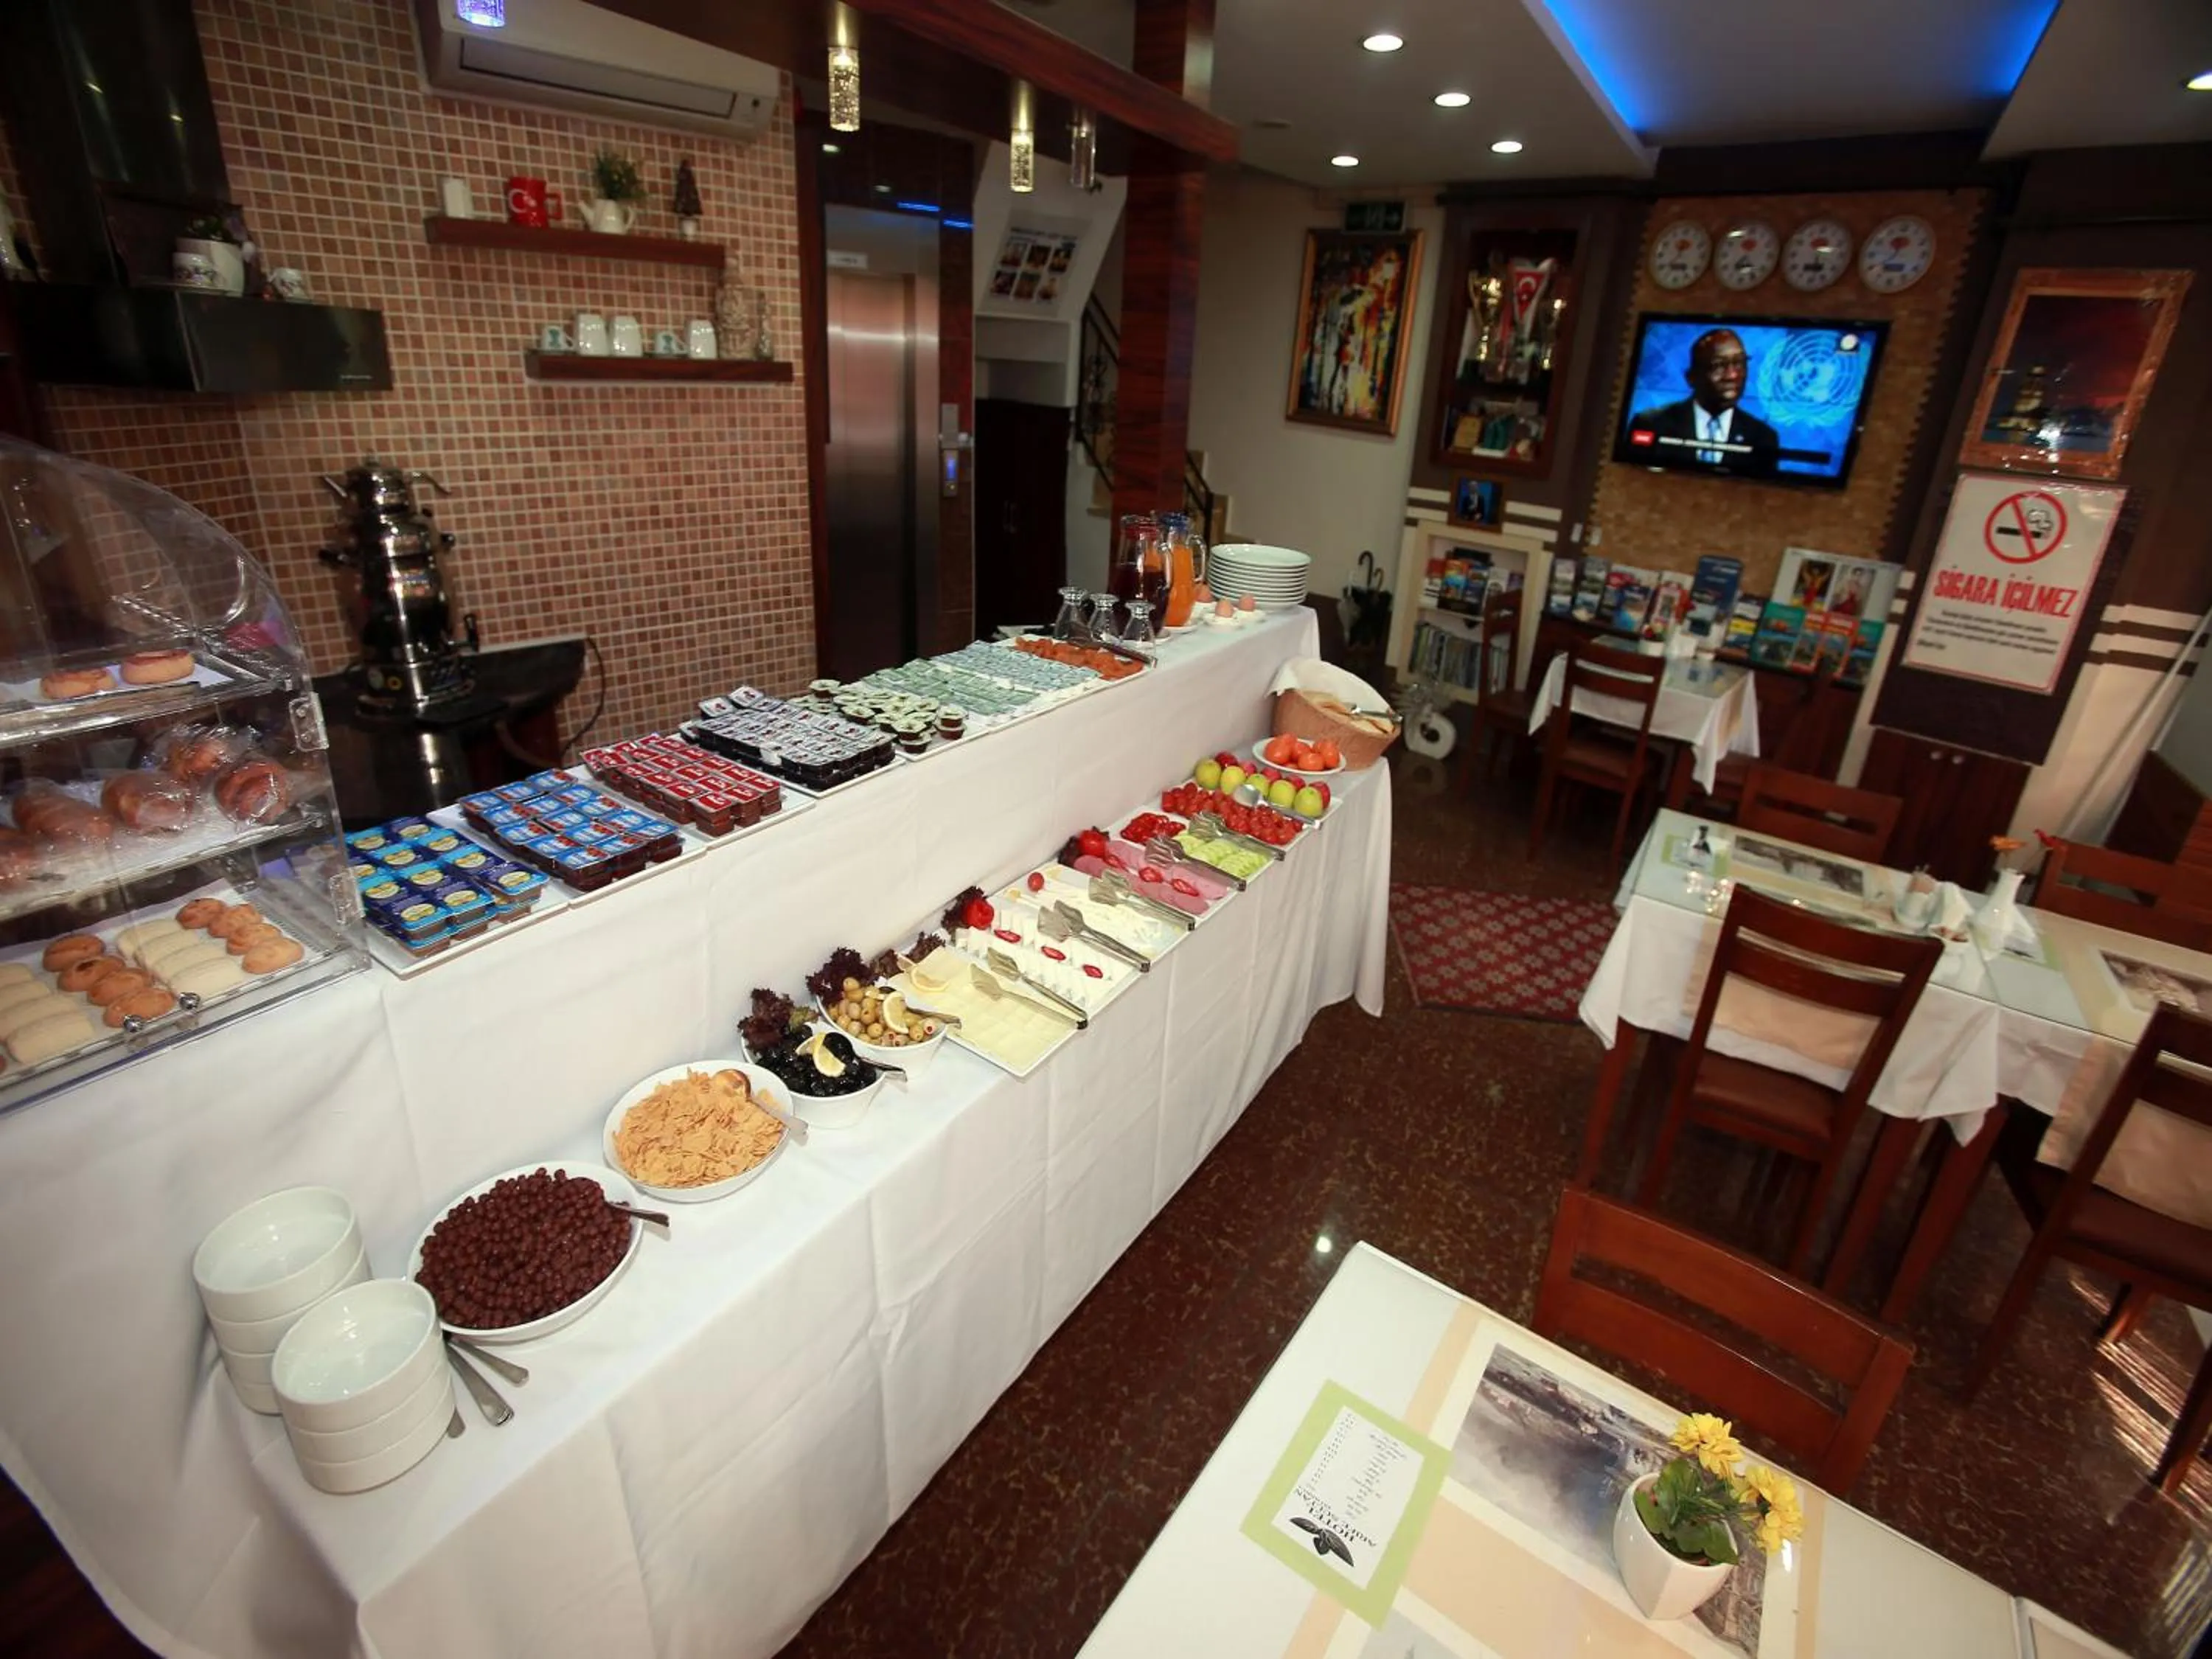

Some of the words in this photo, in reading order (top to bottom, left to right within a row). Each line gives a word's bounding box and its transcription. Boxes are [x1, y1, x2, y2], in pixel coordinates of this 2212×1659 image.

[1934, 565, 1999, 605] SİGARA
[2000, 573, 2078, 618] İÇİLMEZ
[1307, 1503, 1354, 1542] HOTEL
